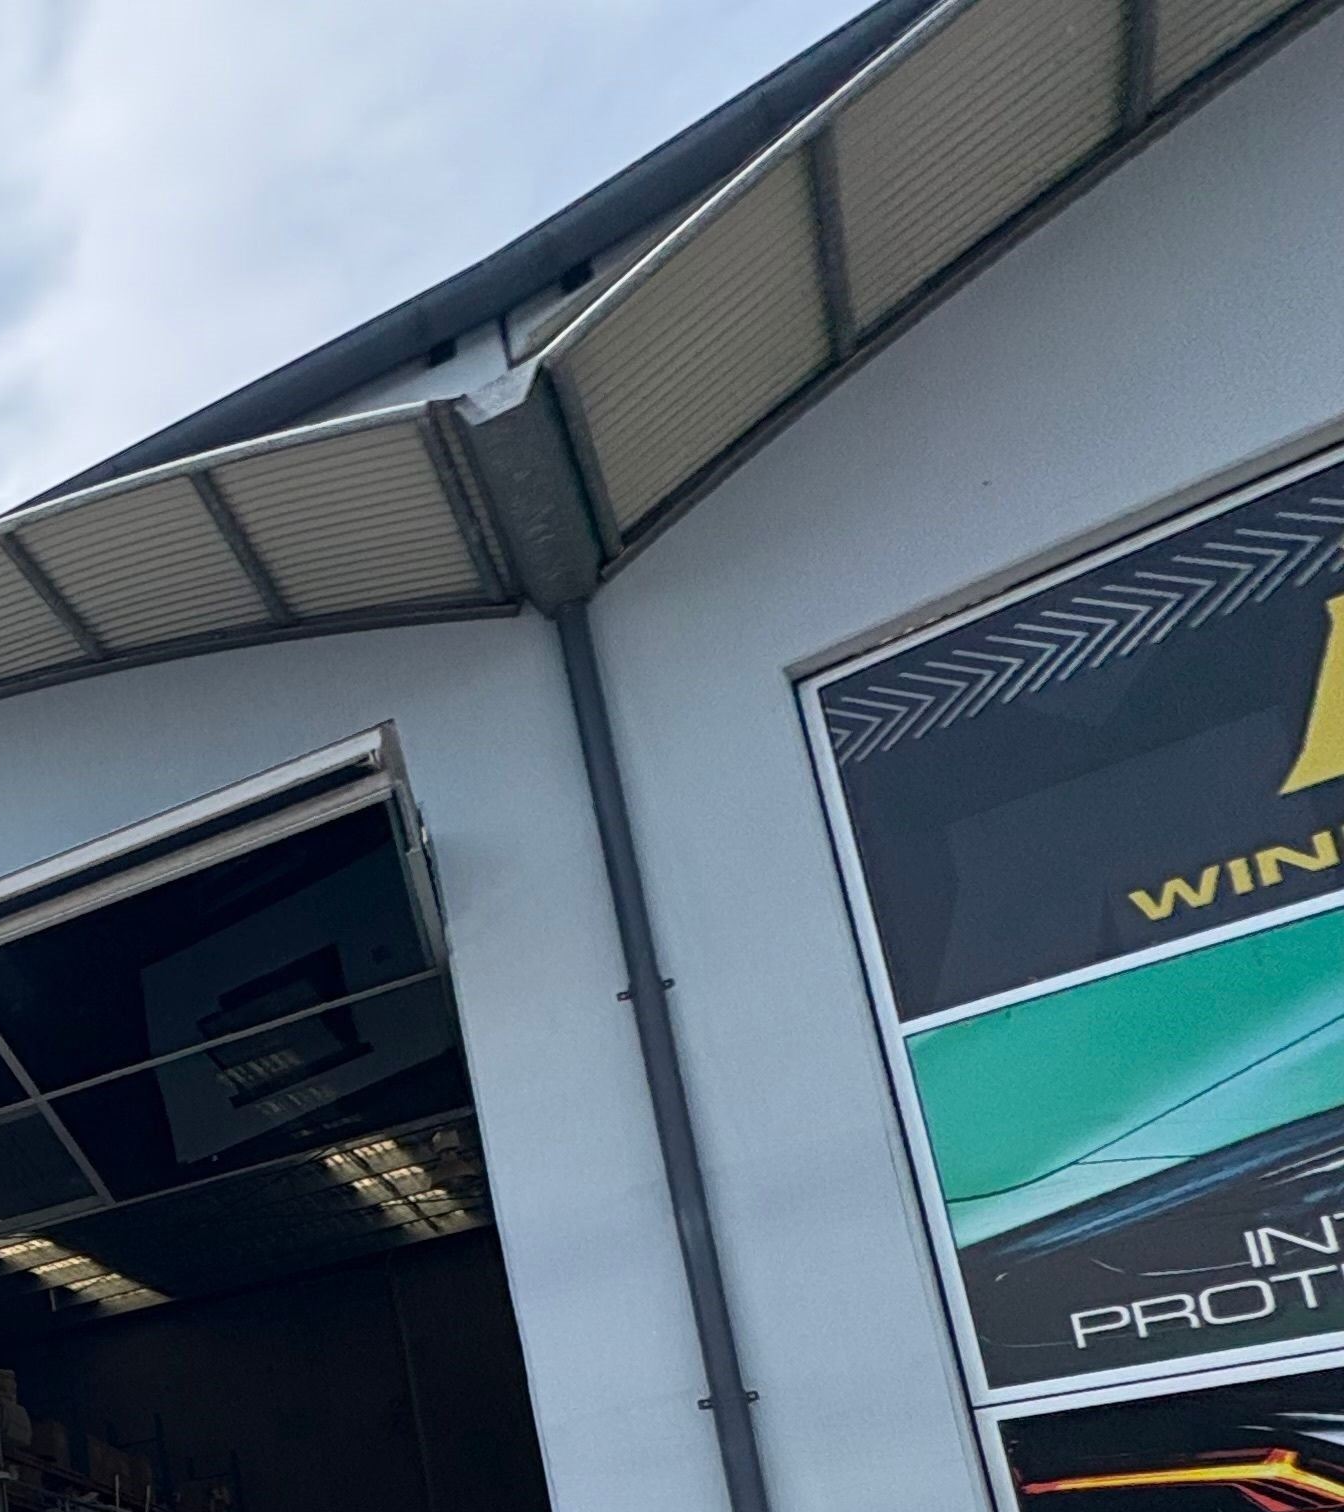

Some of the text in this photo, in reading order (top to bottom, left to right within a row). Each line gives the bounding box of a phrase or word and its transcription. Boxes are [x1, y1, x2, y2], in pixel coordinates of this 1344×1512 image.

[1128, 824, 1344, 921] WIN
[1242, 1211, 1344, 1268] IN
[1070, 1263, 1344, 1349] PROT
